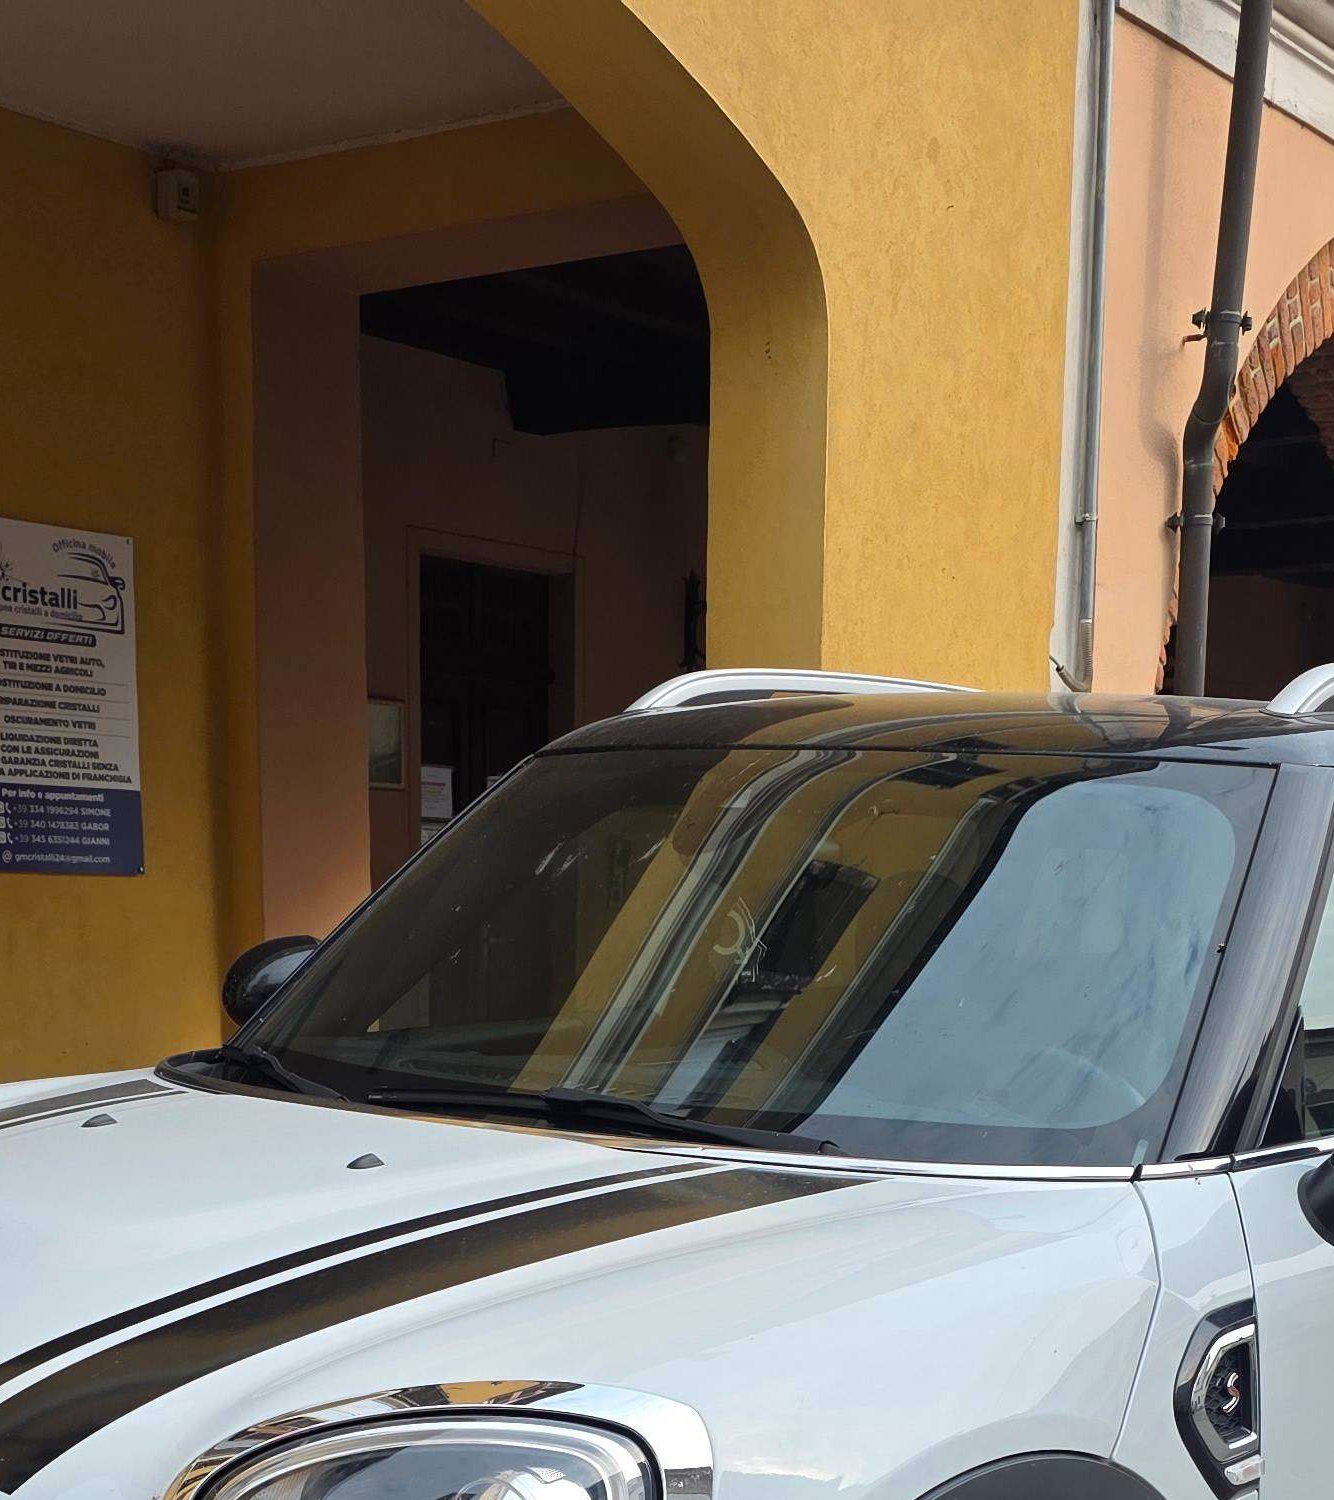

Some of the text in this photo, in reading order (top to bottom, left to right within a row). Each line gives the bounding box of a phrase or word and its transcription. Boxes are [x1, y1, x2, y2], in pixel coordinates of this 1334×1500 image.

[2, 581, 78, 610] cristalli
[0, 625, 94, 646] SERVIZI OFFERTI
